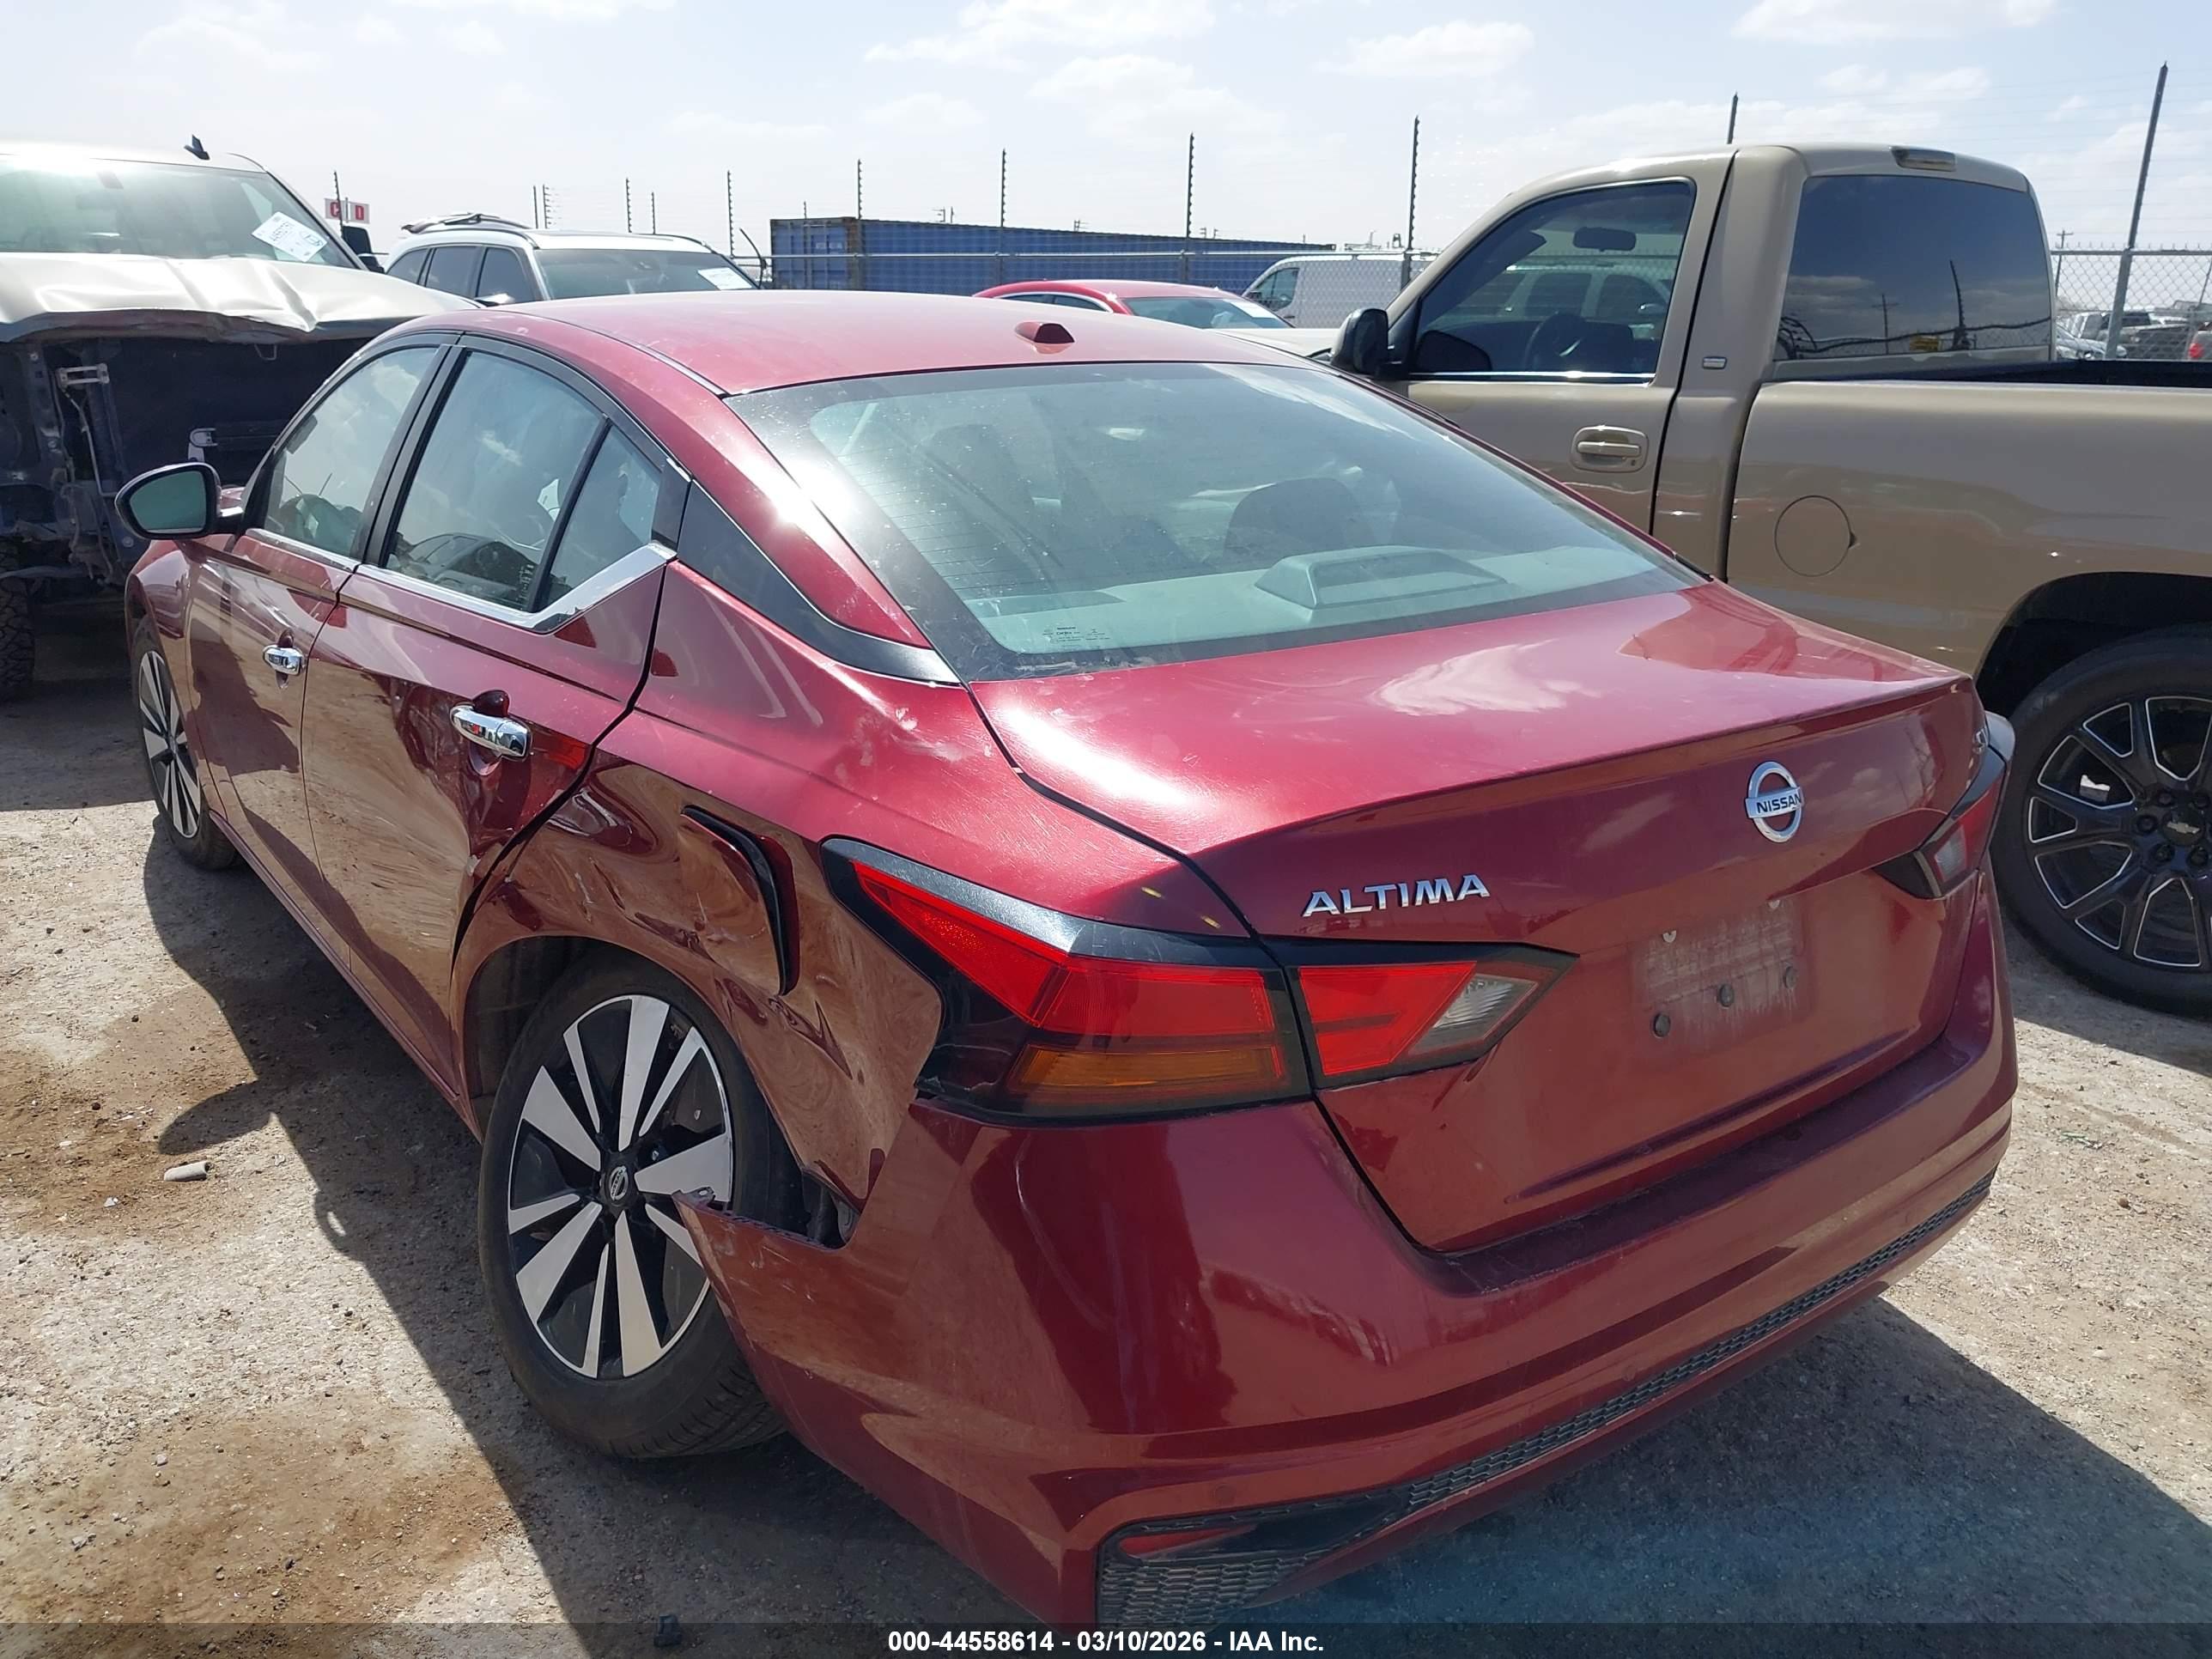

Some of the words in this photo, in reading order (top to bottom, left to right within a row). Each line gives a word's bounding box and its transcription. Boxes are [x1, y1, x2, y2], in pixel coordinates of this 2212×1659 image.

[355, 204, 364, 221] D
[1756, 793, 1802, 814] NISSAN
[1303, 874, 1490, 917] ALTIMA
